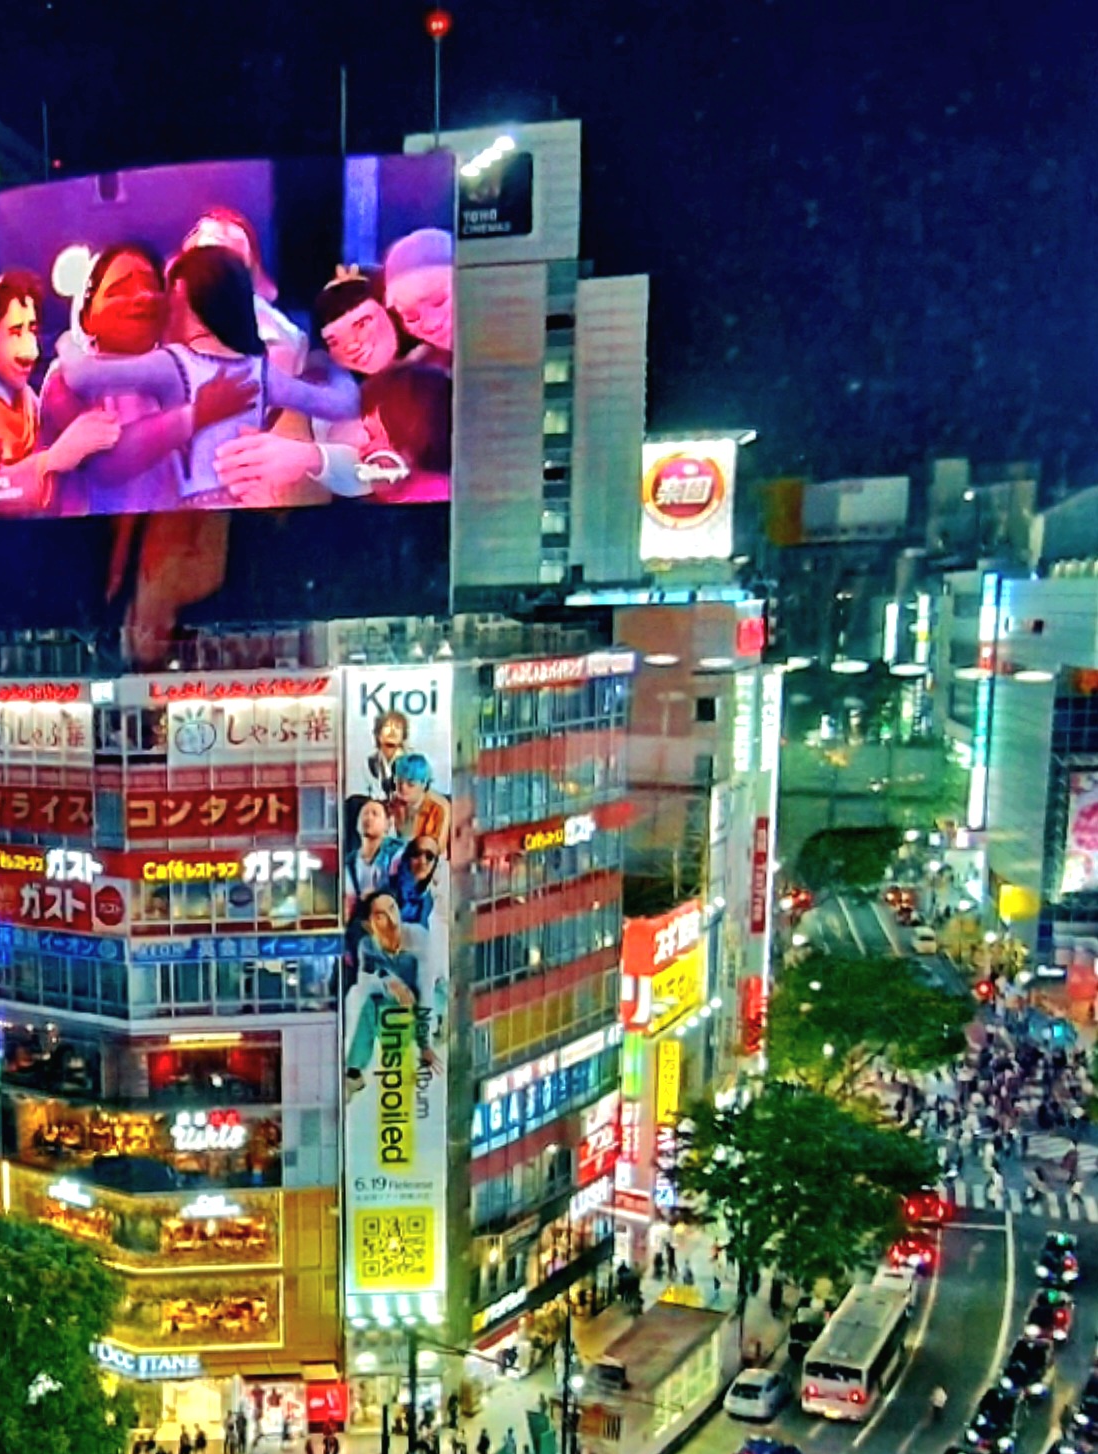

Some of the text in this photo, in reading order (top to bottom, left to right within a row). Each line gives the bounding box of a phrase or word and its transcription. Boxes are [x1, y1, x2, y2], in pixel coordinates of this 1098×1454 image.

[360, 680, 438, 717] Kroi
[129, 793, 291, 827] コンタクト
[45, 848, 103, 884] ガスト
[242, 850, 323, 883] ガスト
[19, 881, 87, 923] ガスト
[374, 1007, 410, 1164] Unspoiled
[355, 1176, 388, 1192] 6.19
